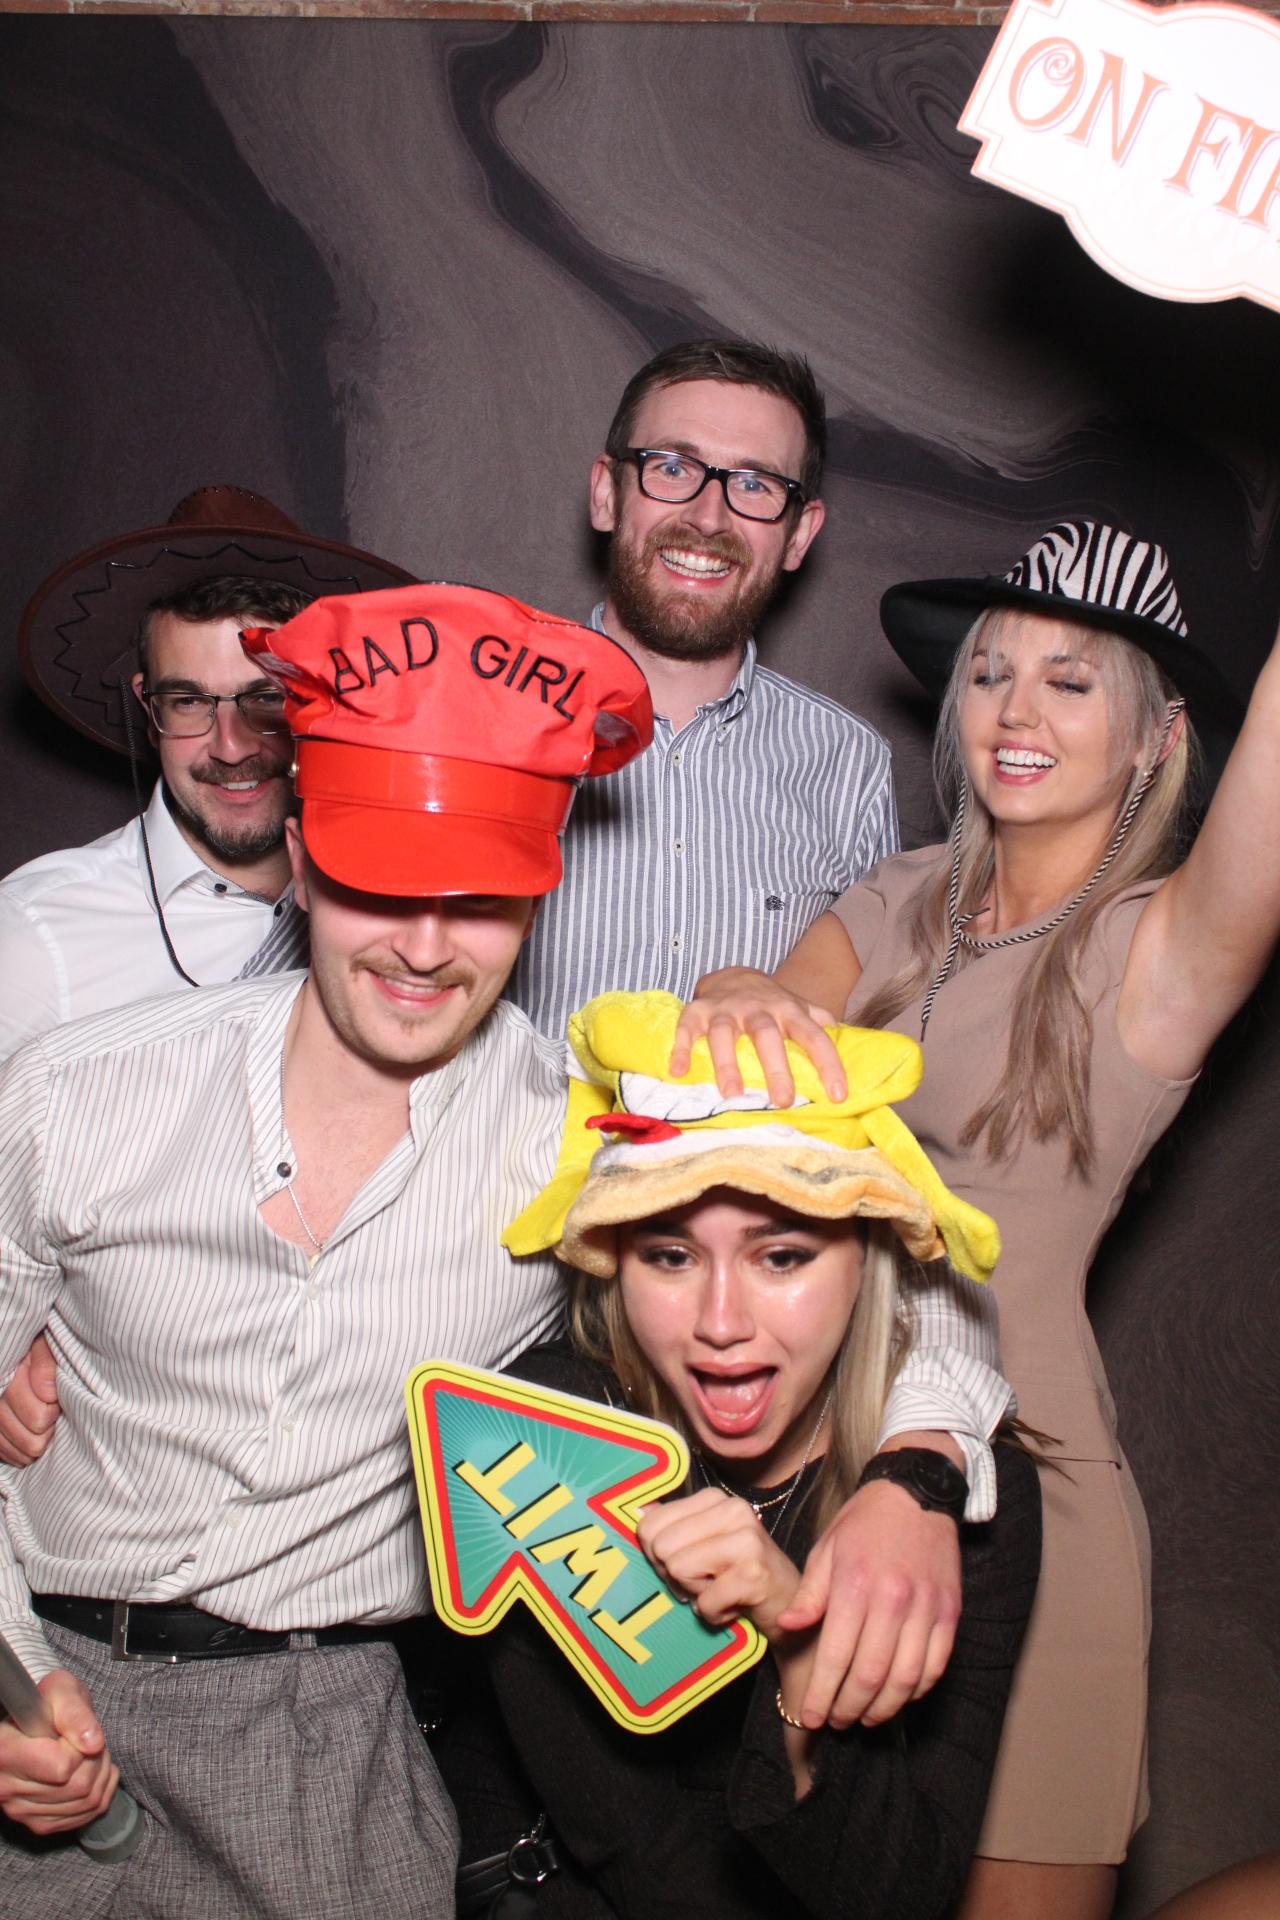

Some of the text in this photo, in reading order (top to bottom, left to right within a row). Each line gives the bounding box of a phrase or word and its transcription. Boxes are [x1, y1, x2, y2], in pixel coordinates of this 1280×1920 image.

[1008, 36, 1171, 168] ON
[328, 616, 586, 721] BAD GIRL
[452, 1441, 674, 1666] TWIT
